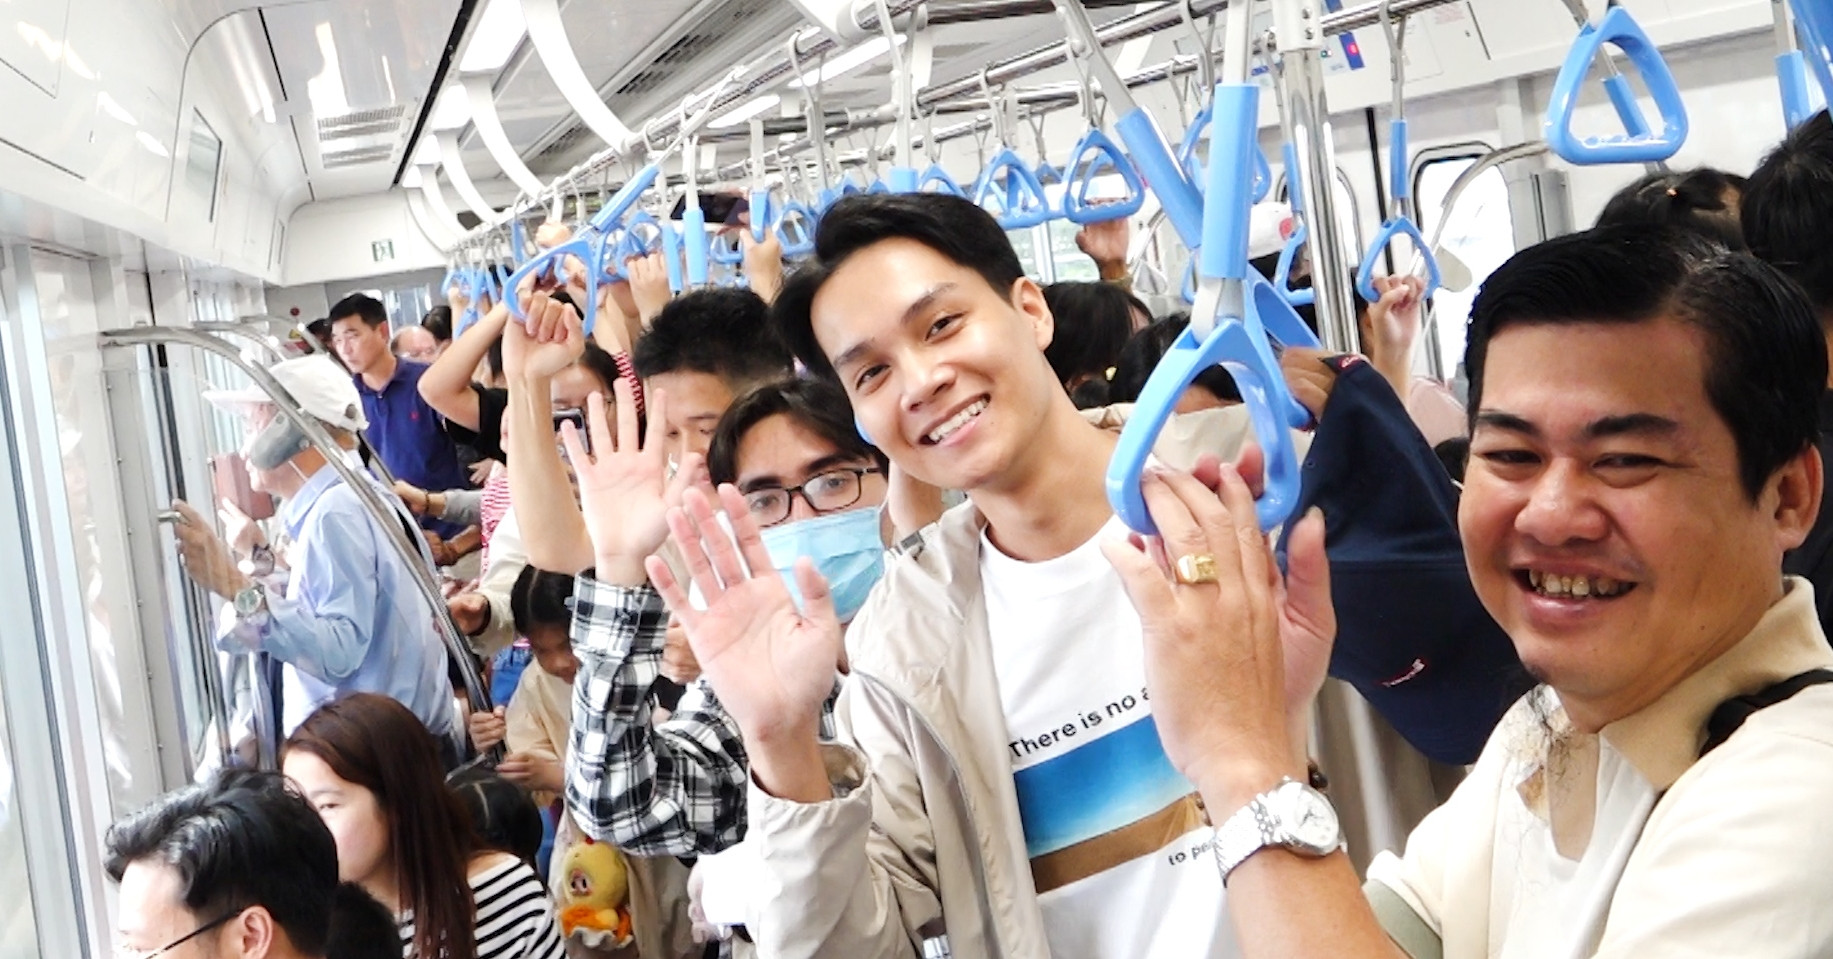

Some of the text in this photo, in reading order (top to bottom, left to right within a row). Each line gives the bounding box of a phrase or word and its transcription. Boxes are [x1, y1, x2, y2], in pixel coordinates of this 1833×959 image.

[1008, 723, 1077, 758] There
[1077, 711, 1103, 729] is
[1105, 695, 1137, 718] no
[1168, 851, 1187, 866] to
